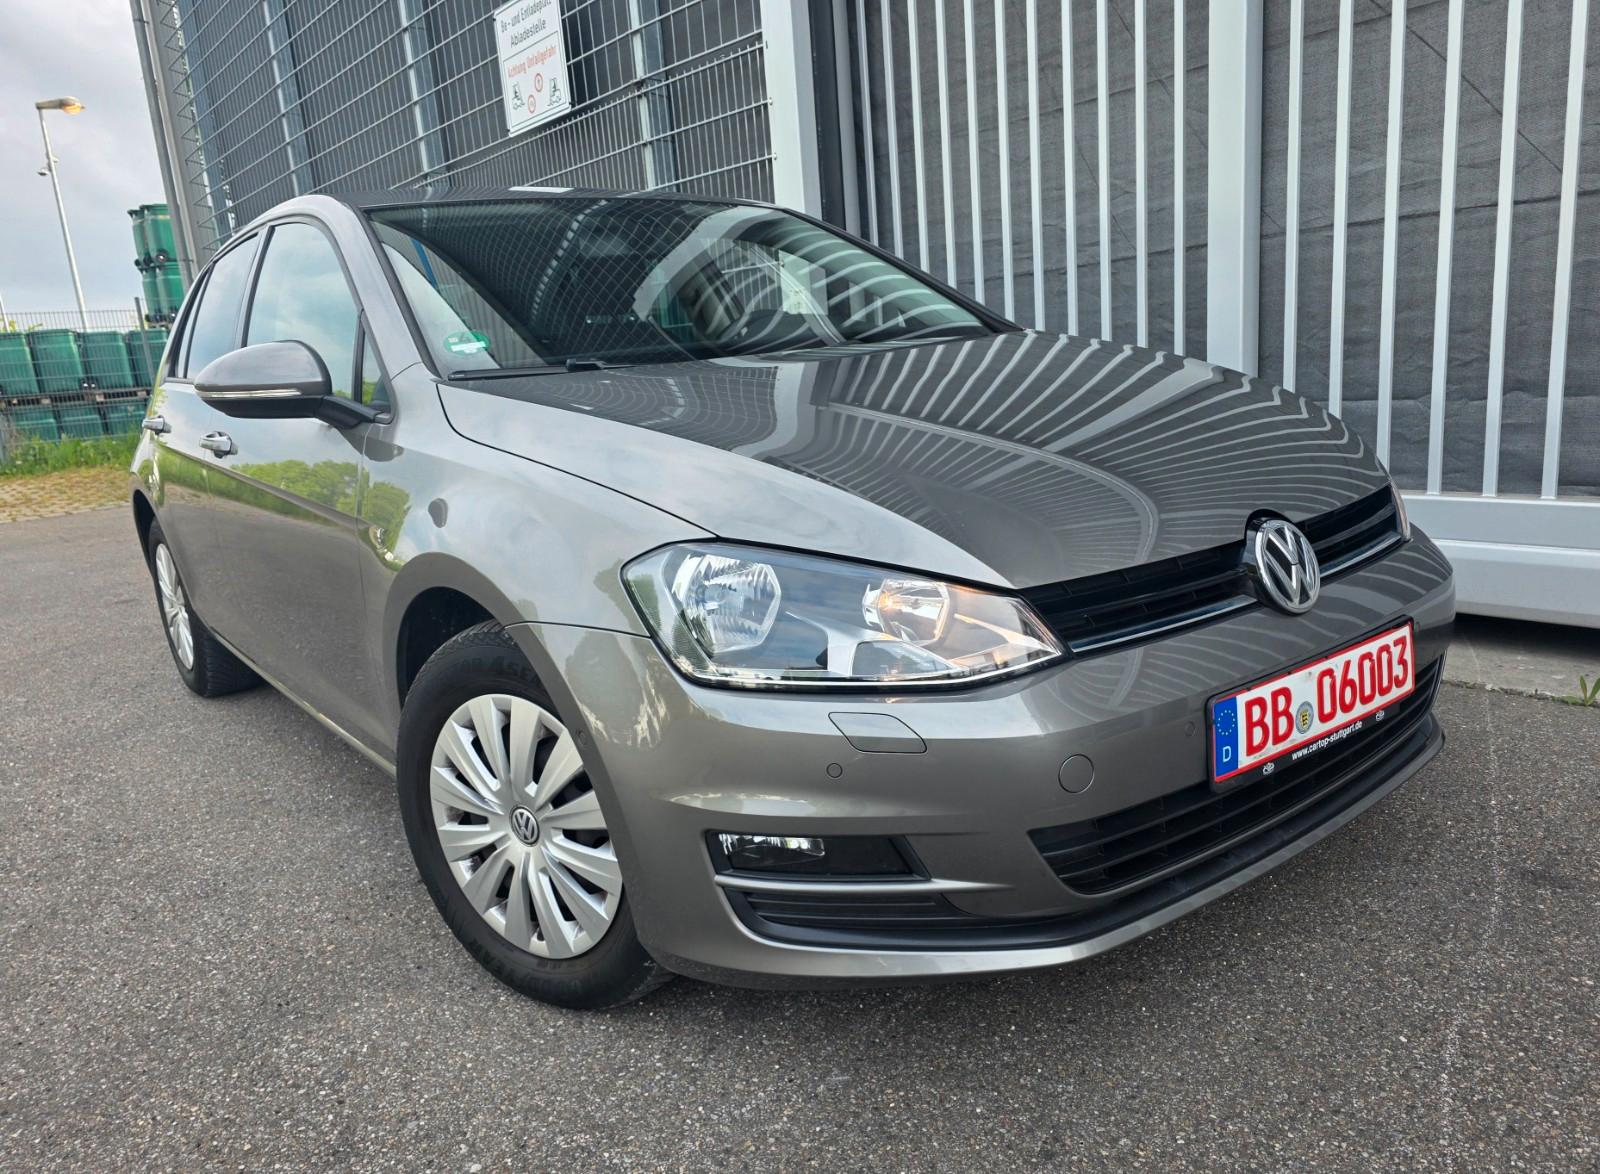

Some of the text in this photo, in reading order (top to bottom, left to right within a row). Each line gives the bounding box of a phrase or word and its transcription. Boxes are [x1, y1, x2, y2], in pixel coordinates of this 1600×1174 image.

[511, 10, 520, 27] und
[511, 18, 546, 47] Abladestelle
[508, 45, 556, 78] Achtung Unfallgefahr
[1245, 635, 1409, 757] BB 06003
[1222, 746, 1232, 762] D
[1292, 720, 1363, 760] www.cartop-stuttgart.de
